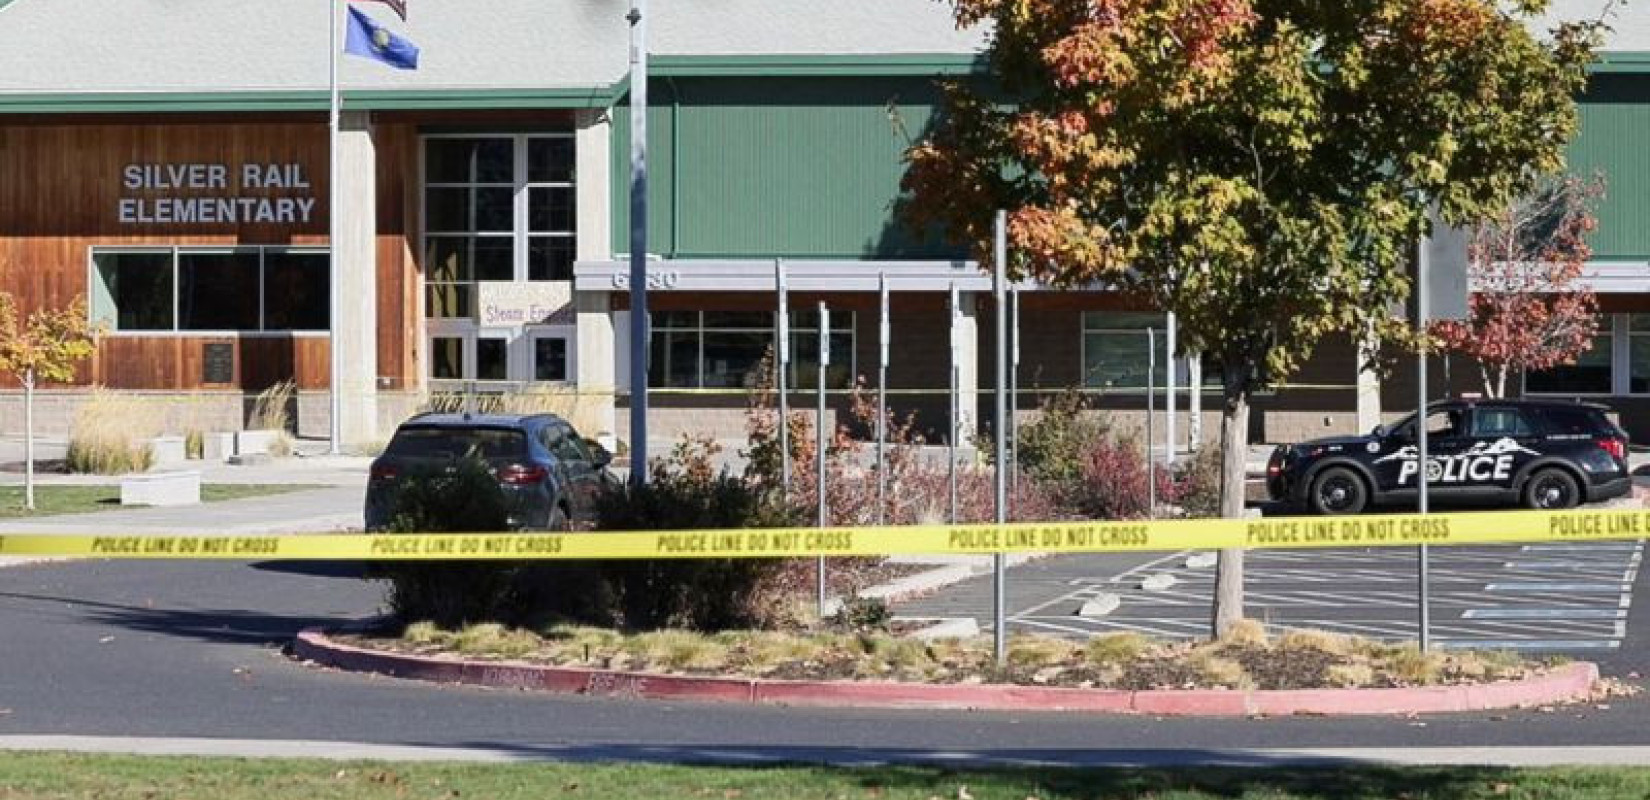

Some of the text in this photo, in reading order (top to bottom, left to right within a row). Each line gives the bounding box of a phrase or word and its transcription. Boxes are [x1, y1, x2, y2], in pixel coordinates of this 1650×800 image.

[123, 163, 310, 189] SILVER RAIL
[118, 197, 315, 223] ELEMENTARY
[611, 272, 678, 289] 630
[1397, 454, 1514, 485] POLICE
[1247, 518, 1449, 543] POLICE LINE DO NOT CROSS
[1550, 514, 1601, 534] POLICE
[1607, 513, 1641, 533] LINE
[91, 537, 279, 552] POLICE LINE DO NOT CROSS
[370, 536, 563, 553] POLICE LINE DO NOT CROSS
[657, 531, 852, 552] POLICE LINE DO NOT CROSS
[949, 525, 1149, 549] POLICE LINE DO NOT CROSS
